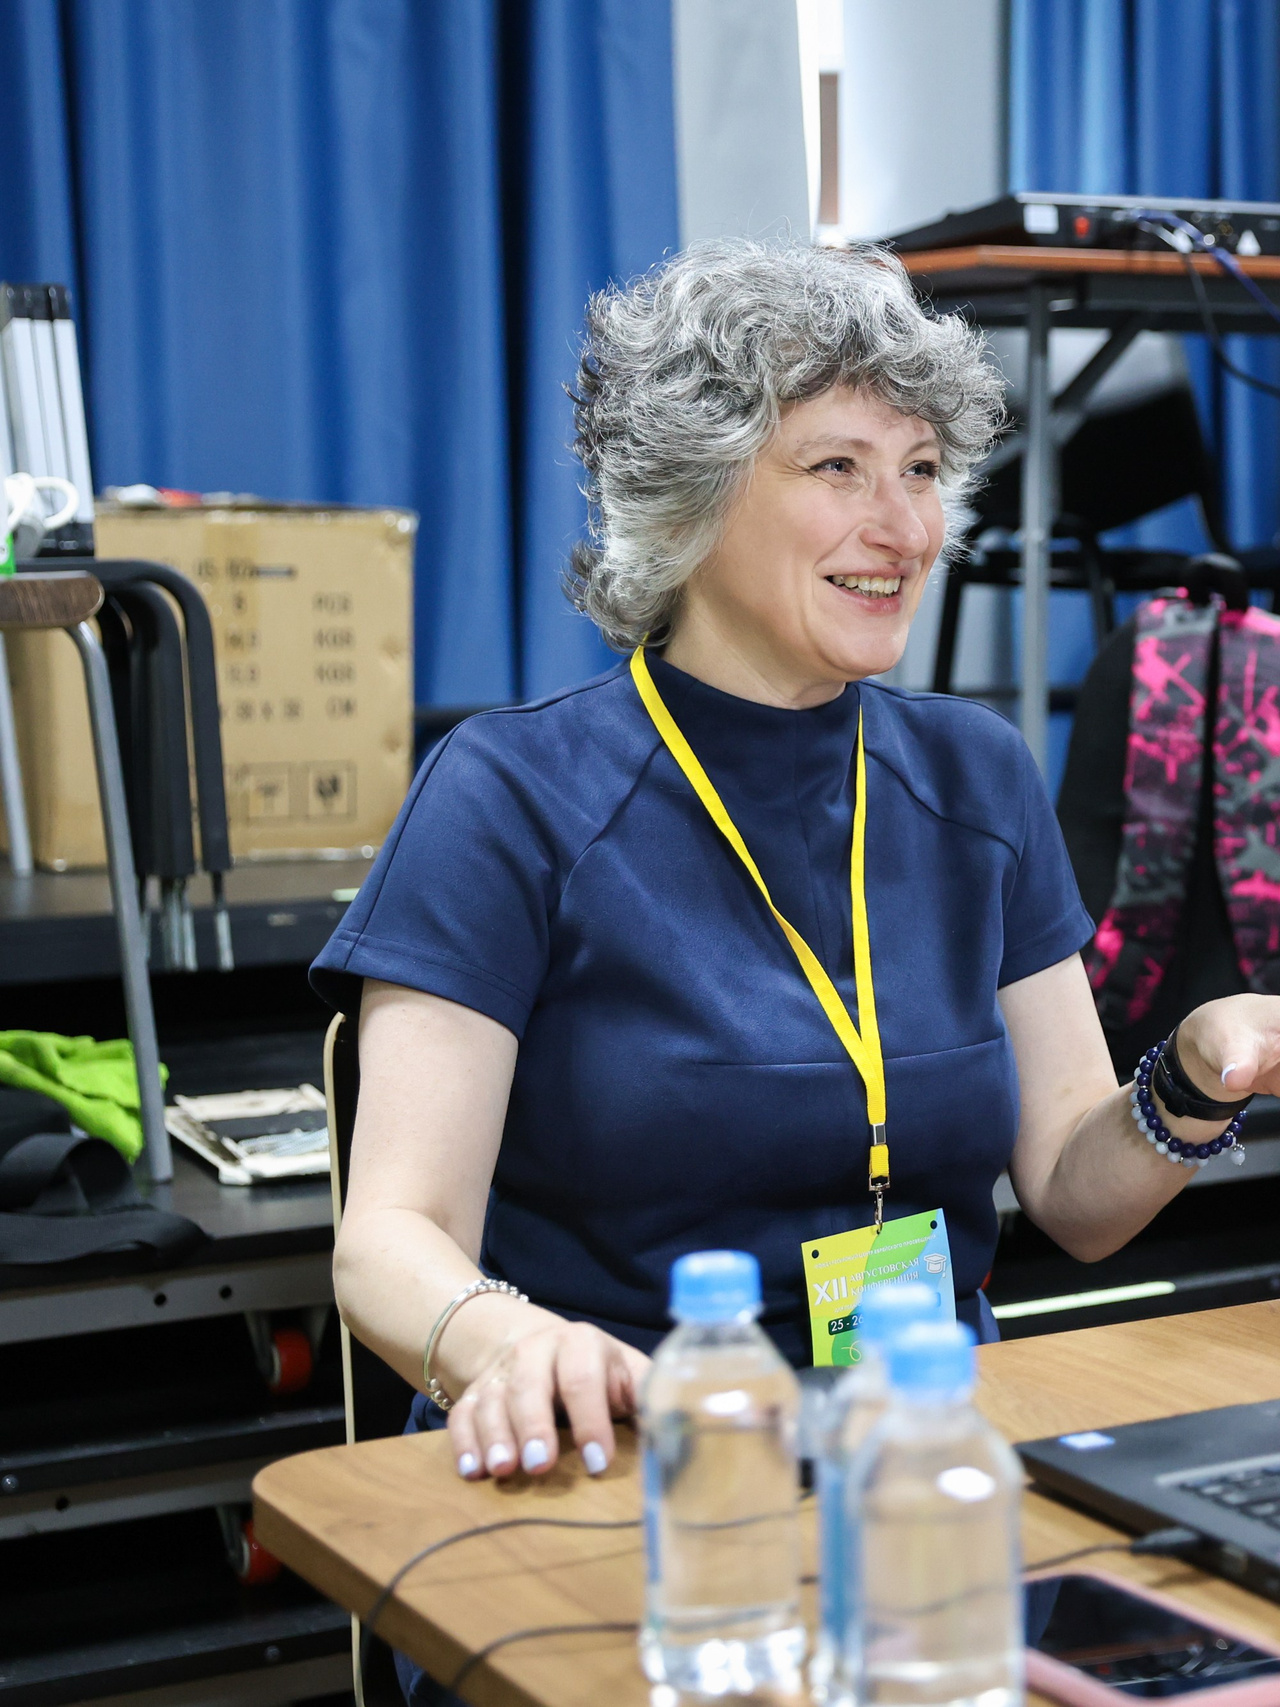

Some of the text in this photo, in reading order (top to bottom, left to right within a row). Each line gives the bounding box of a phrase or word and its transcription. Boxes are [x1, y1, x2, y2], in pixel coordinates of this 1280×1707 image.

[850, 1257, 920, 1282] АВГУСТОВСКАЯ
[812, 1276, 848, 1306] XII
[851, 1270, 920, 1296] КОНФЕРЕНЦИЯ
[830, 1318, 844, 1332] 25
